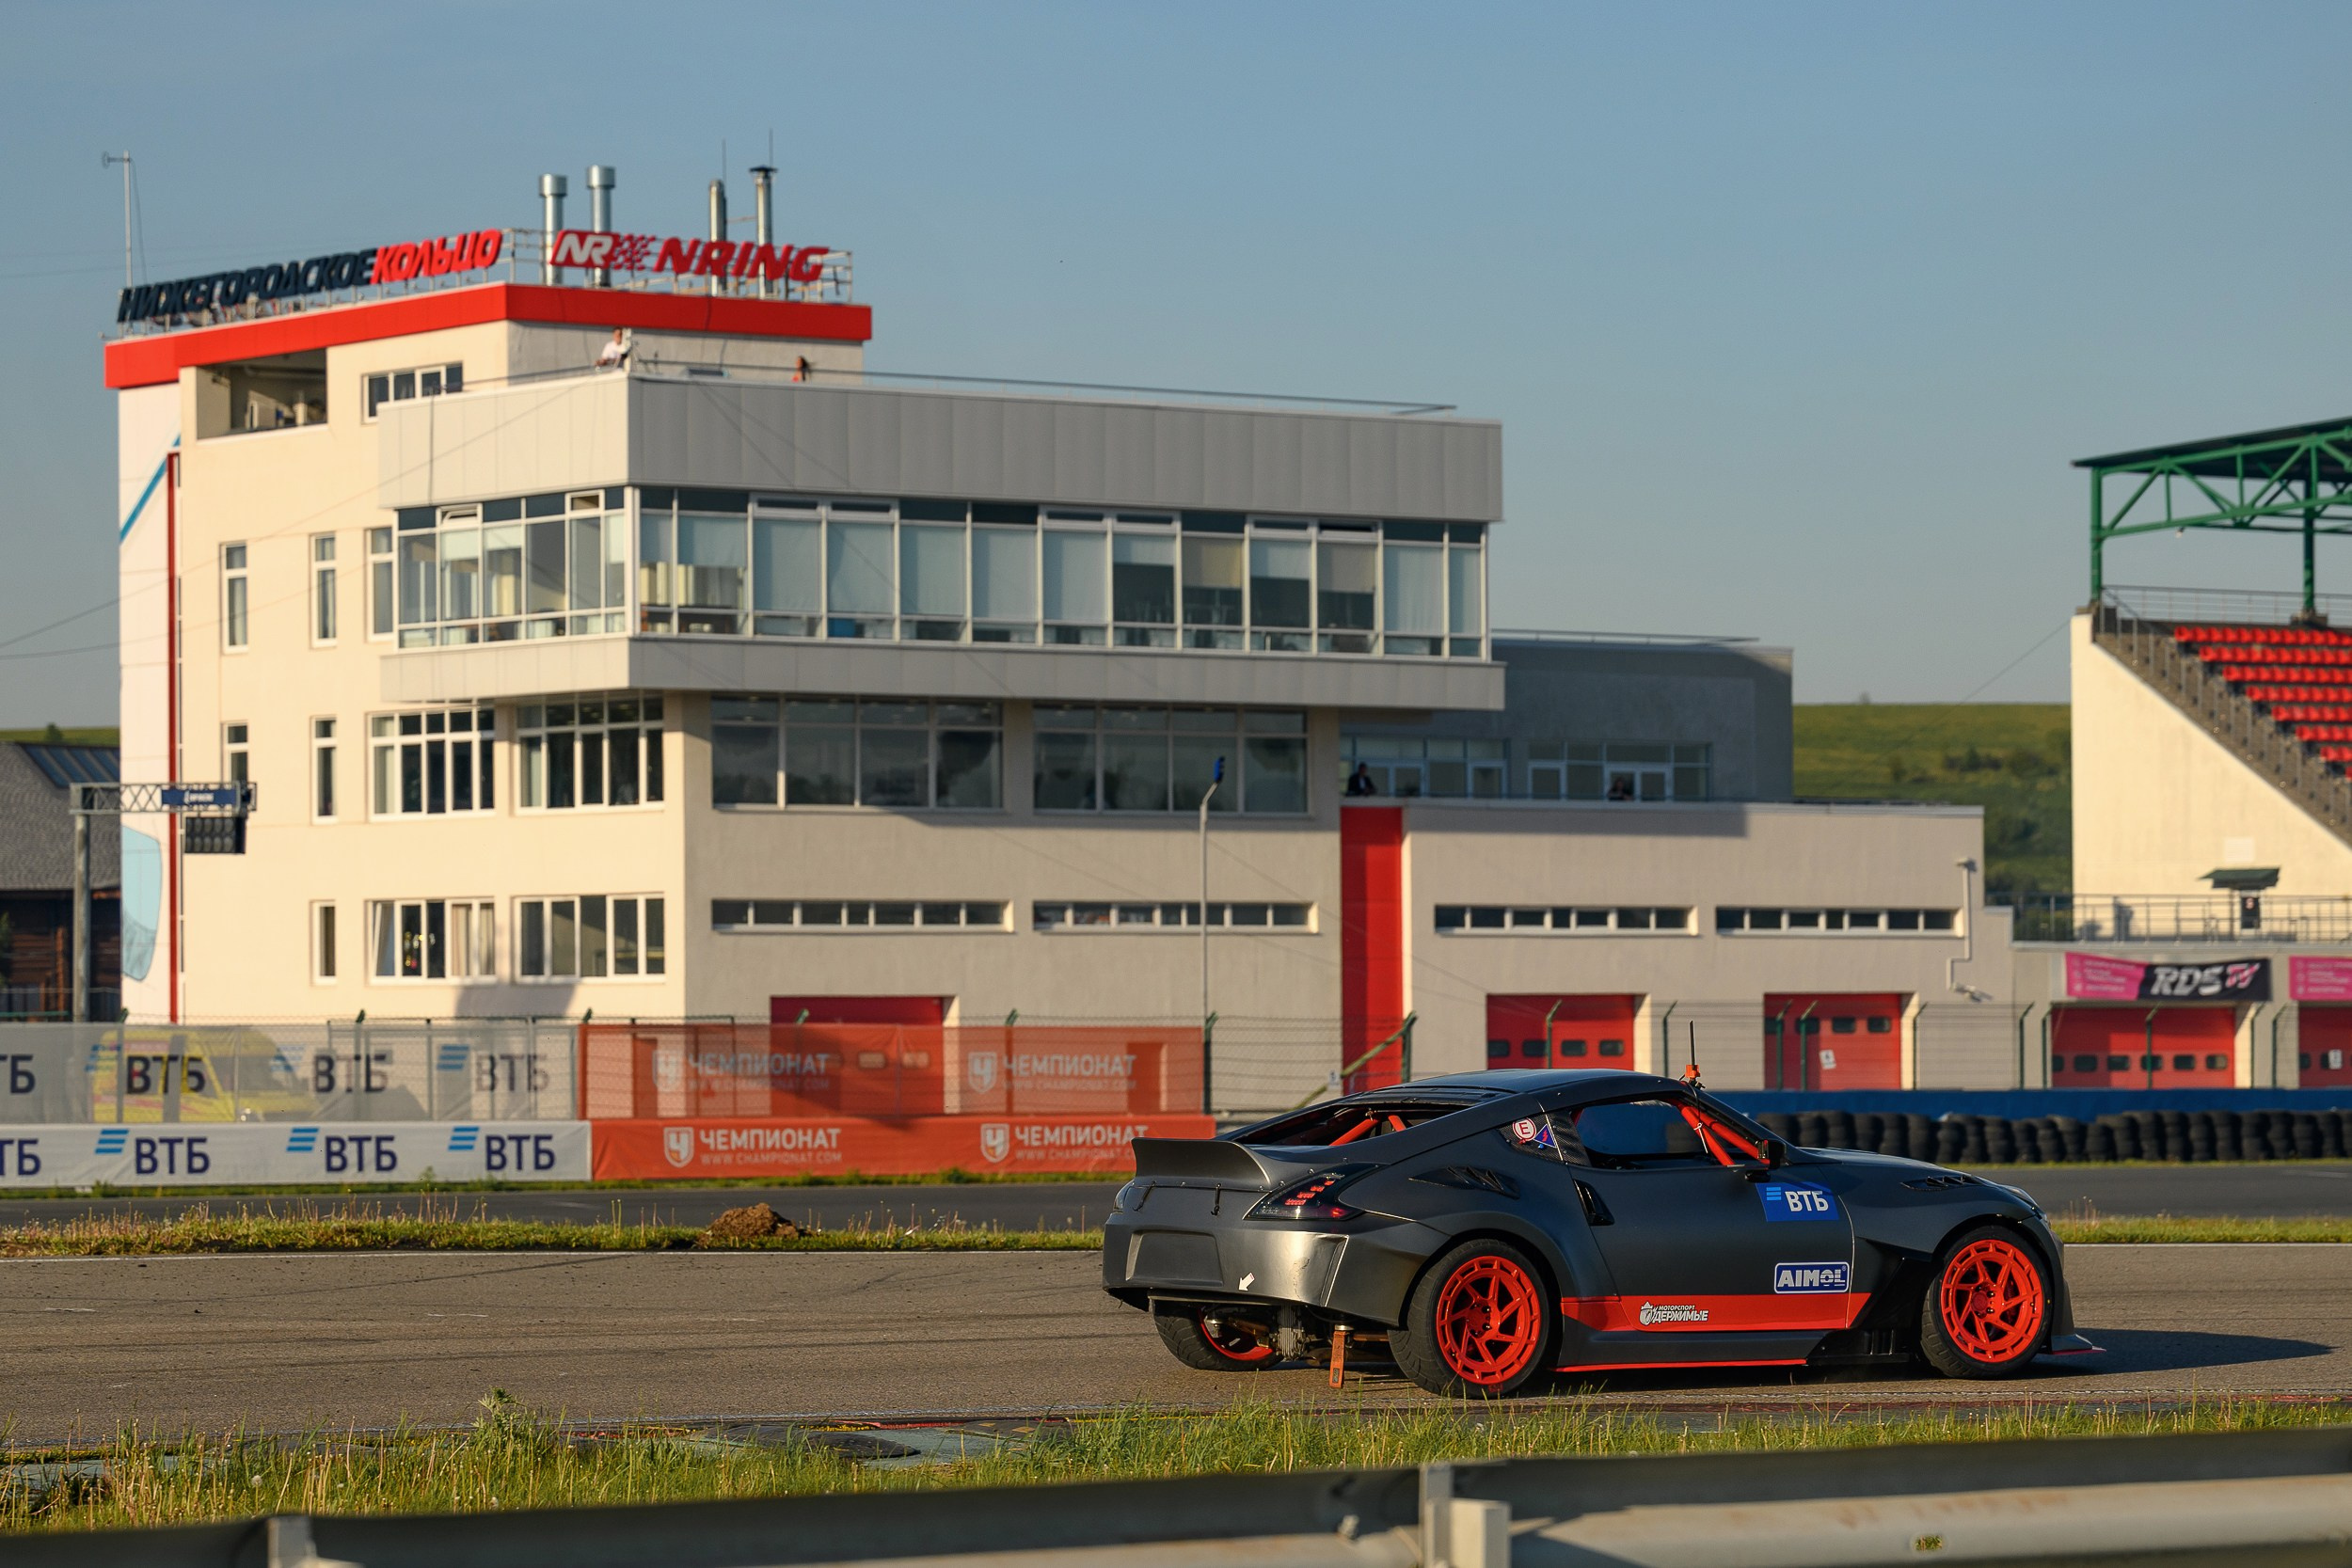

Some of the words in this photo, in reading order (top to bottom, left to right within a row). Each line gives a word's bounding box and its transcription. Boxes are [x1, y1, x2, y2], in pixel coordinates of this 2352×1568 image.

[117, 248, 377, 323] НИЖЕГОРОДСКОЕ
[371, 229, 503, 285] КОЛЬЦО
[653, 237, 830, 282] NRING
[2150, 965, 2224, 996] RDS
[126, 1054, 206, 1095] ВТБ
[313, 1053, 389, 1093] ВТБ
[475, 1053, 550, 1092] ВТБ
[688, 1053, 829, 1076] ЧЕМПИОНАТ
[1003, 1053, 1137, 1076] ЧЕМПИОНАТ
[699, 1128, 841, 1150] ЧЕМПИОНАТ
[1518, 1122, 1531, 1135] E
[135, 1136, 210, 1175] ВТБ
[325, 1135, 398, 1172] ВТБ
[485, 1134, 555, 1171] ВТБ
[1785, 1190, 1829, 1212] ВТБ
[1777, 1269, 1846, 1287] AIMOL
